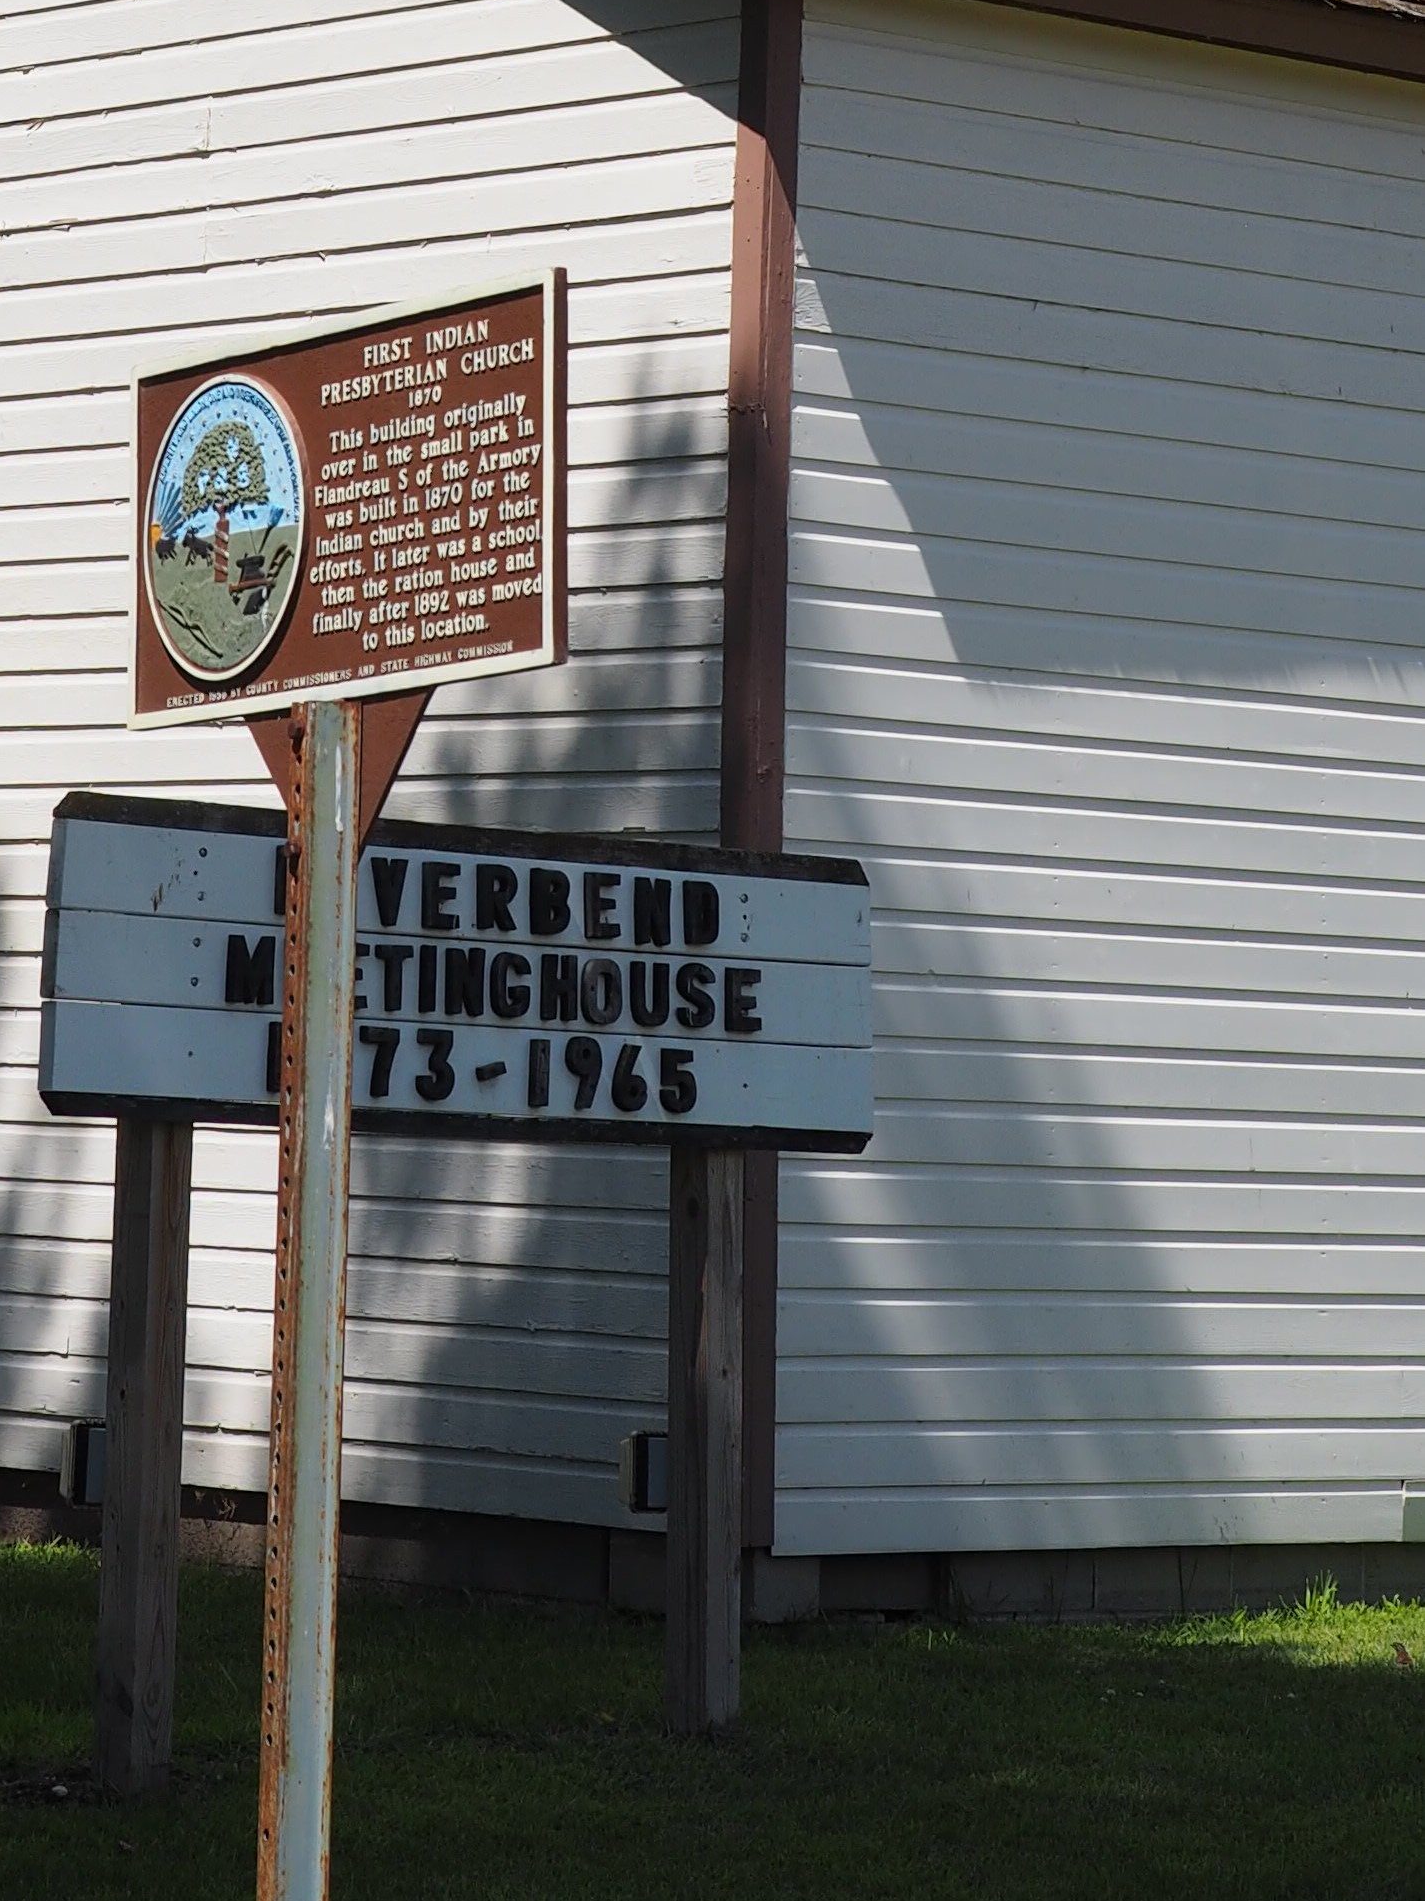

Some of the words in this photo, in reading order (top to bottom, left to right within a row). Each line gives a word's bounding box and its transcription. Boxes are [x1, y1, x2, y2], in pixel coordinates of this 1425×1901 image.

[321, 358, 448, 406] PRESBYTERIAN
[461, 338, 535, 375] CHURCH
[363, 337, 412, 369] FIRST
[425, 319, 489, 354] INDIAN
[329, 428, 363, 453] This
[370, 414, 435, 444] building
[444, 392, 526, 428] originally
[408, 386, 442, 408] 1870
[314, 477, 390, 507] Flandreau
[398, 468, 408, 490] S
[416, 463, 433, 486] of
[442, 459, 469, 481] the
[477, 444, 542, 474] Armory
[321, 458, 356, 480] over
[363, 451, 378, 472] in
[386, 445, 413, 466] the
[420, 430, 462, 459] small
[470, 420, 509, 451] park
[517, 416, 534, 438] in
[315, 532, 363, 557] Indian
[369, 519, 424, 546] church
[431, 510, 461, 534] and
[469, 506, 489, 529] by
[498, 495, 539, 521] their
[325, 508, 353, 529] was
[359, 498, 397, 523] built
[402, 494, 419, 514] in
[425, 483, 462, 510] 1870
[471, 477, 495, 500] for
[503, 470, 530, 492] the
[321, 584, 355, 606] then
[362, 577, 388, 599] the
[395, 568, 443, 593] ration
[450, 557, 498, 583] house
[505, 547, 535, 572] and
[373, 550, 386, 572] It
[392, 545, 431, 569] later
[437, 539, 465, 560] was
[472, 535, 482, 552] a
[312, 608, 363, 634] finally
[369, 601, 410, 624] after
[414, 590, 450, 616] 1892
[456, 585, 485, 607] was
[492, 573, 543, 601] moved
[363, 632, 378, 651] to
[385, 622, 415, 645] this
[421, 613, 490, 640] location.
[166, 692, 205, 708] ERECTED
[230, 688, 241, 698] BY
[245, 681, 278, 696] COUNTY
[283, 668, 352, 690] COMMISSIONERS
[358, 664, 375, 677] AND
[380, 658, 409, 673] STATE
[414, 652, 452, 667] HIGHWAY
[458, 640, 514, 659] COMMISSION
[274, 845, 720, 947] VERBEND
[225, 934, 763, 1032] MTINGHOUSE
[267, 1021, 697, 1113] 173-1965
